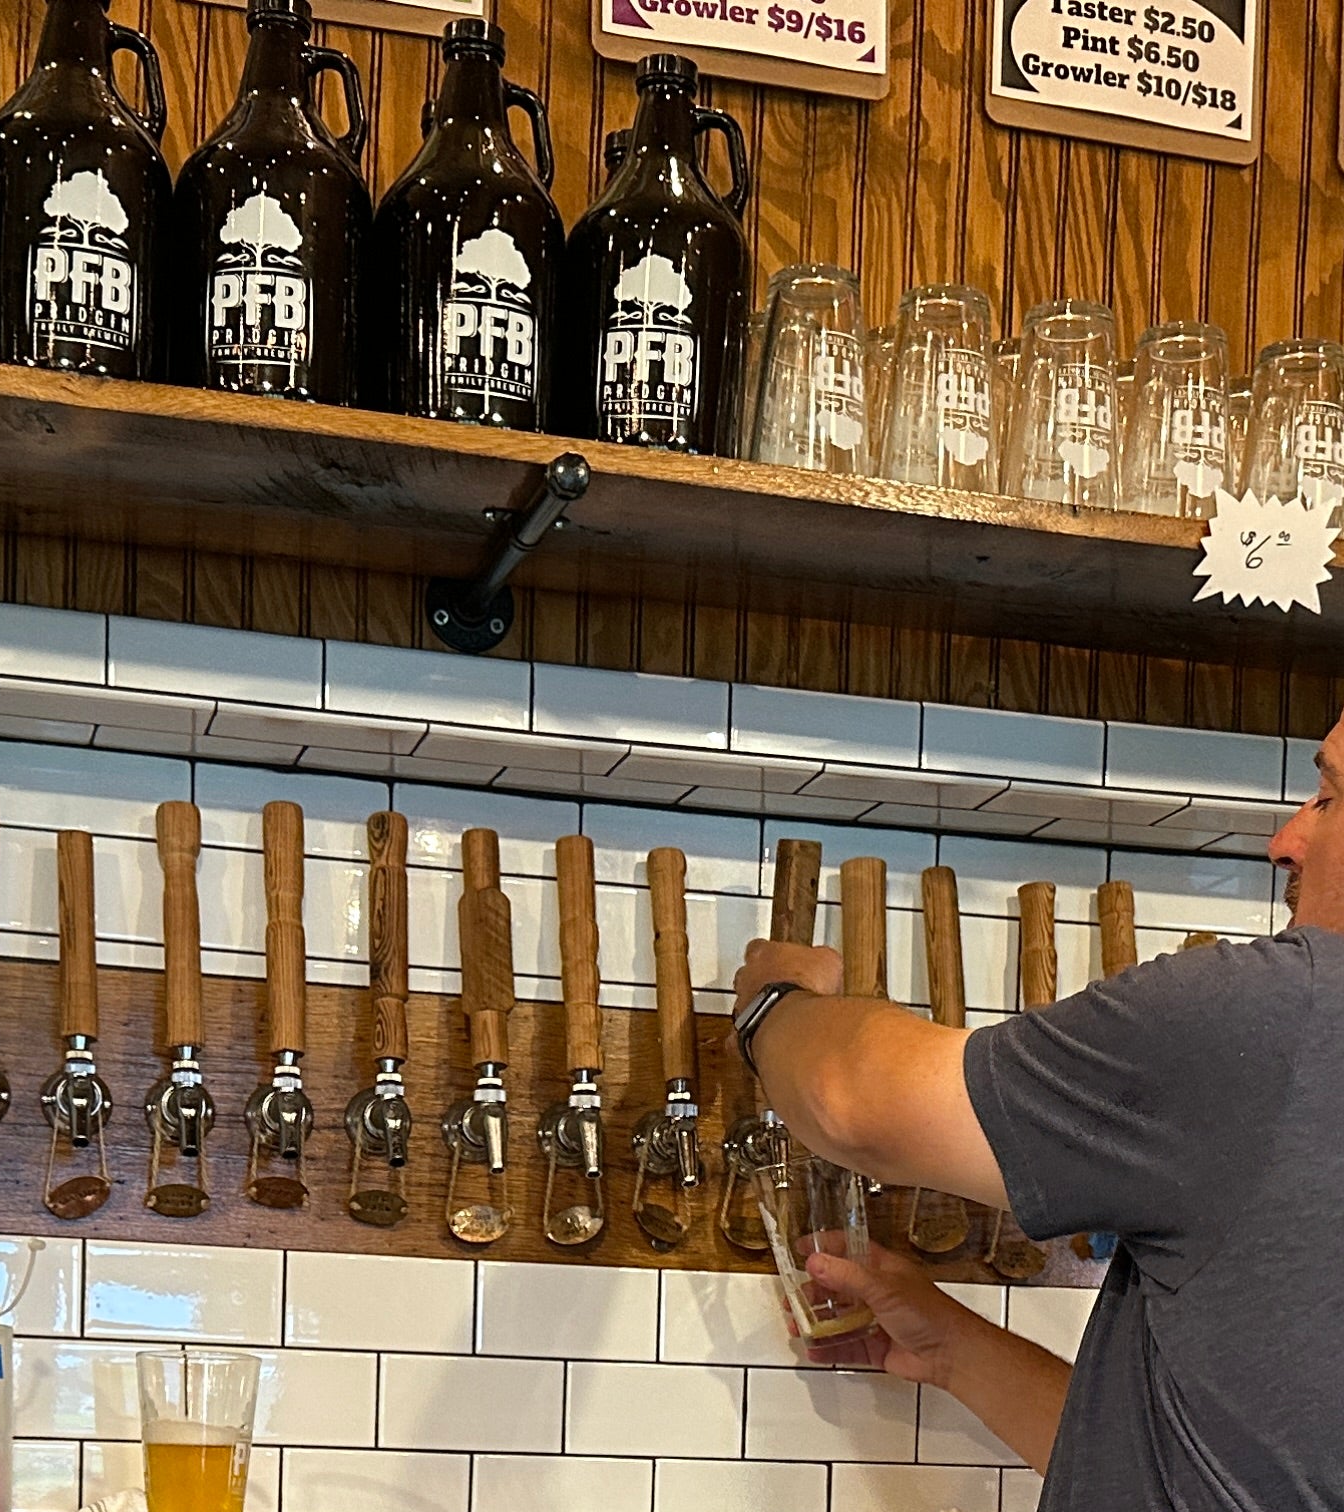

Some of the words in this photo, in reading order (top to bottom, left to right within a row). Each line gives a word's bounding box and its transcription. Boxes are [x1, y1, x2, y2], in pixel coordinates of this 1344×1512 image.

[638, 0, 759, 25] Growler
[767, 3, 866, 44] $9/$16
[1051, 0, 1136, 26] Taster
[1143, 5, 1215, 43] $2.50
[1062, 26, 1120, 56] Pint
[1127, 34, 1200, 72] $6.50
[1022, 53, 1130, 89] Growler
[1137, 69, 1237, 111] $10/$18
[33, 247, 132, 315] PFB
[211, 273, 306, 332] PFB
[443, 303, 533, 366] PFB
[603, 331, 694, 386] PFB
[443, 356, 532, 382] PRIDGIN
